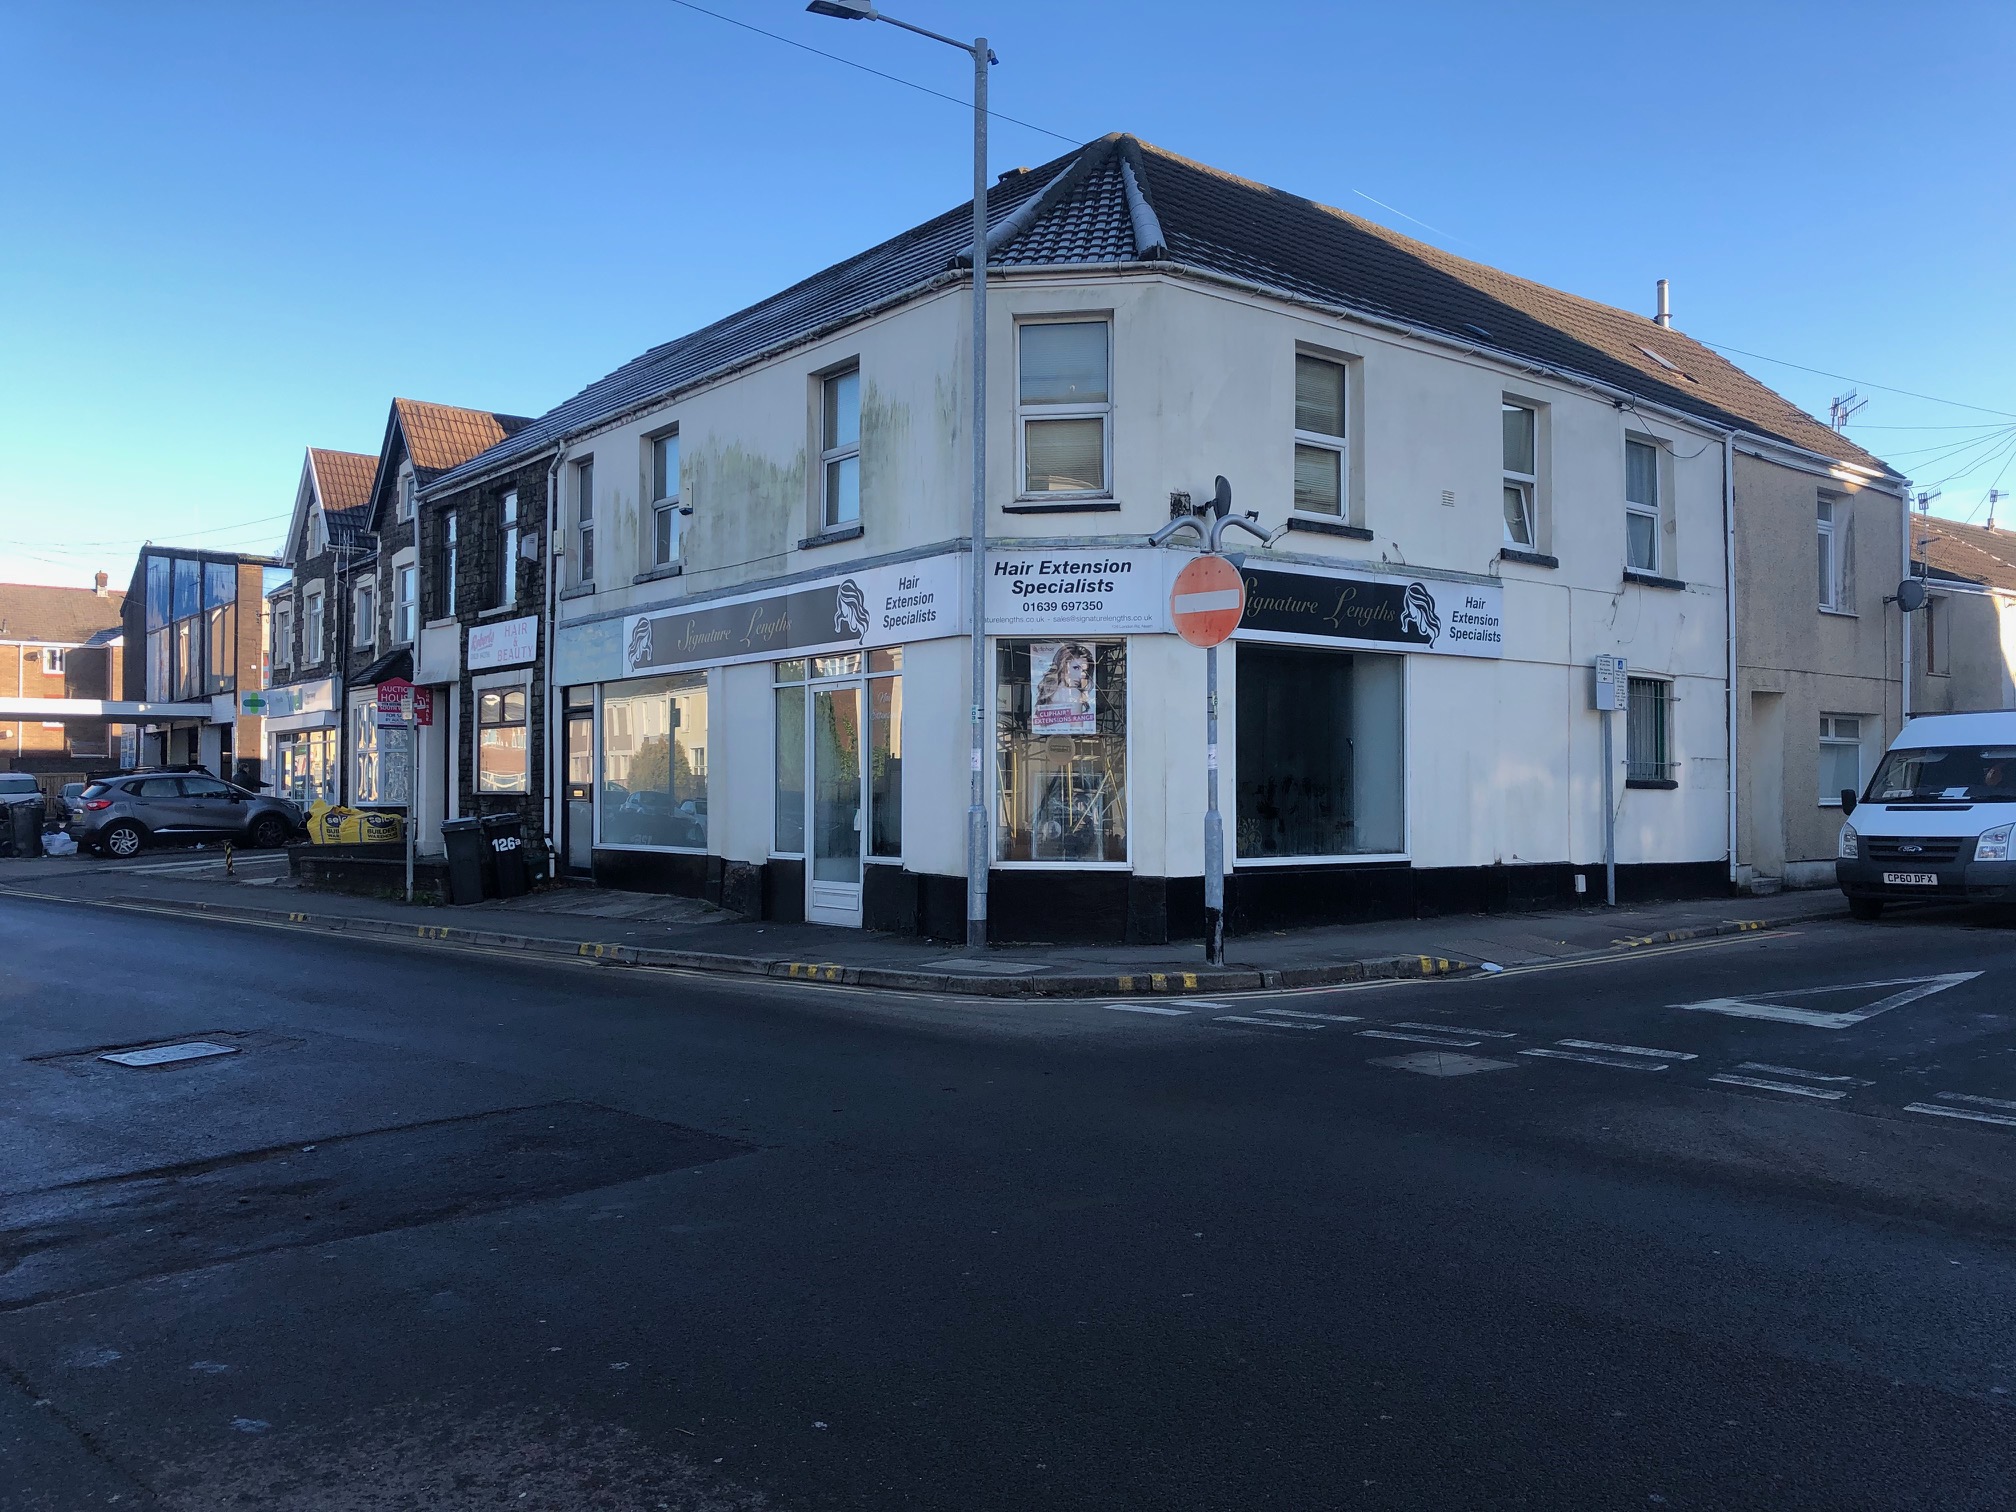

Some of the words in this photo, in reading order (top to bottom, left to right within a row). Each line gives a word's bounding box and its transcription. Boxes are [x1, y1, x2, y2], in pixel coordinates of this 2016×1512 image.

[994, 561, 1033, 576] Hair
[1039, 559, 1132, 575] Extension
[898, 575, 920, 591] Hair
[1011, 578, 1114, 598] Specialists
[885, 592, 934, 611] Extension
[1022, 602, 1058, 612] 01639
[1061, 600, 1103, 611] 697350
[1323, 585, 1396, 629] Lengths
[1465, 596, 1487, 610] Hair
[882, 609, 937, 631] Specialists
[1452, 610, 1499, 627] Extension
[504, 622, 528, 638] HAIR
[678, 619, 731, 652] Signature
[740, 606, 792, 648] Lengths
[1449, 626, 1502, 643] Specialists
[513, 636, 518, 647] &
[497, 645, 533, 662] BEAUTY
[381, 685, 408, 693] AUCTIO
[381, 693, 408, 702] HOUS
[327, 815, 348, 824] selc
[492, 837, 521, 852] 126a
[1887, 874, 1912, 882] CP60
[1914, 874, 1933, 883] DFX
